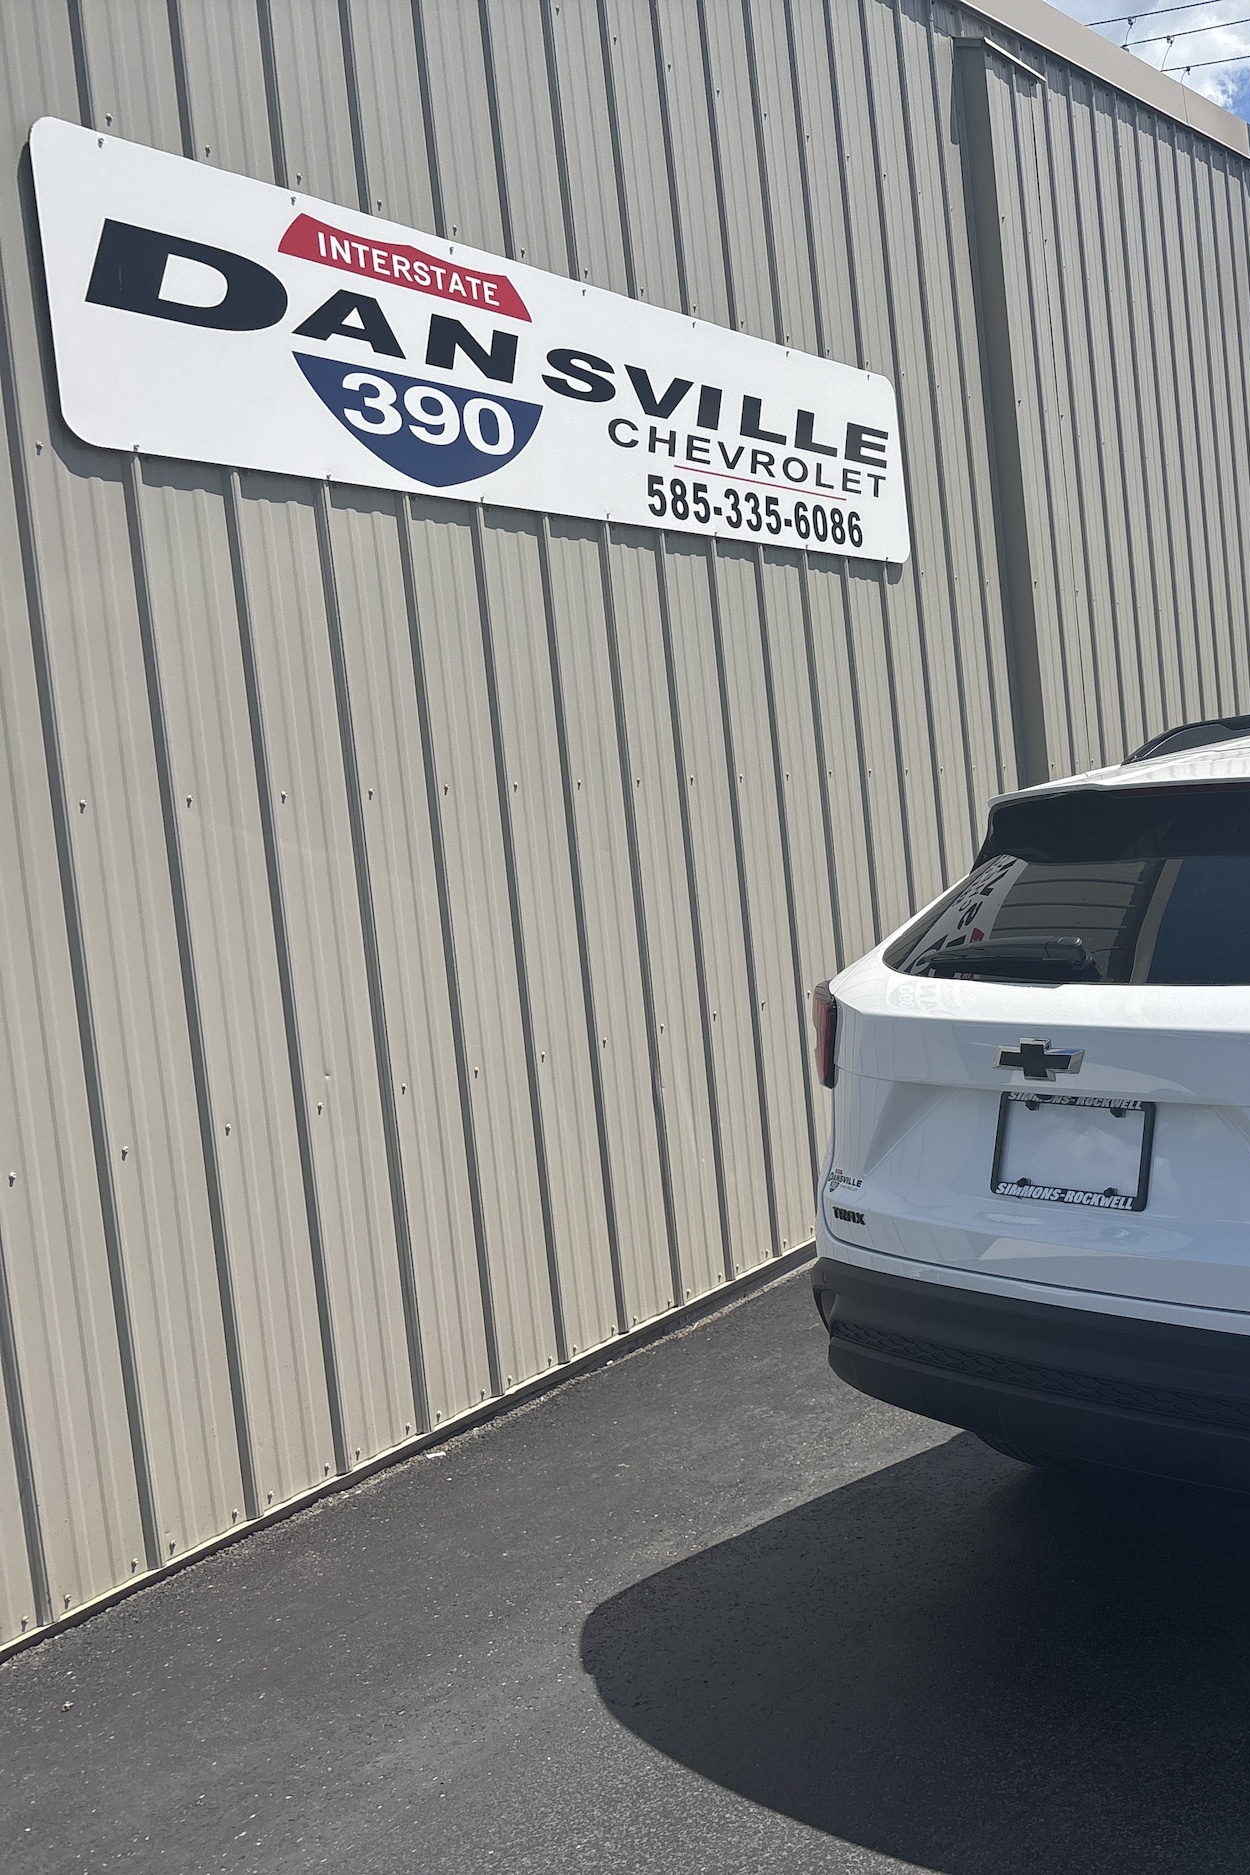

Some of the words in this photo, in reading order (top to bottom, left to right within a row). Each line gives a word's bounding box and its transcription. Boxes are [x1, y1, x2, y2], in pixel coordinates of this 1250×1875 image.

[317, 231, 501, 307] INTERSTATE
[84, 217, 889, 469] DANSVILLE
[341, 372, 515, 456] 390
[607, 418, 887, 499] CHEVROLET
[646, 474, 864, 549] 585-335-6086
[1008, 1091, 1143, 1110] SIMNS-ROCKWELL
[832, 1206, 866, 1226] TRAX
[995, 1182, 1134, 1210] SIMMONS-ROCKWELL
